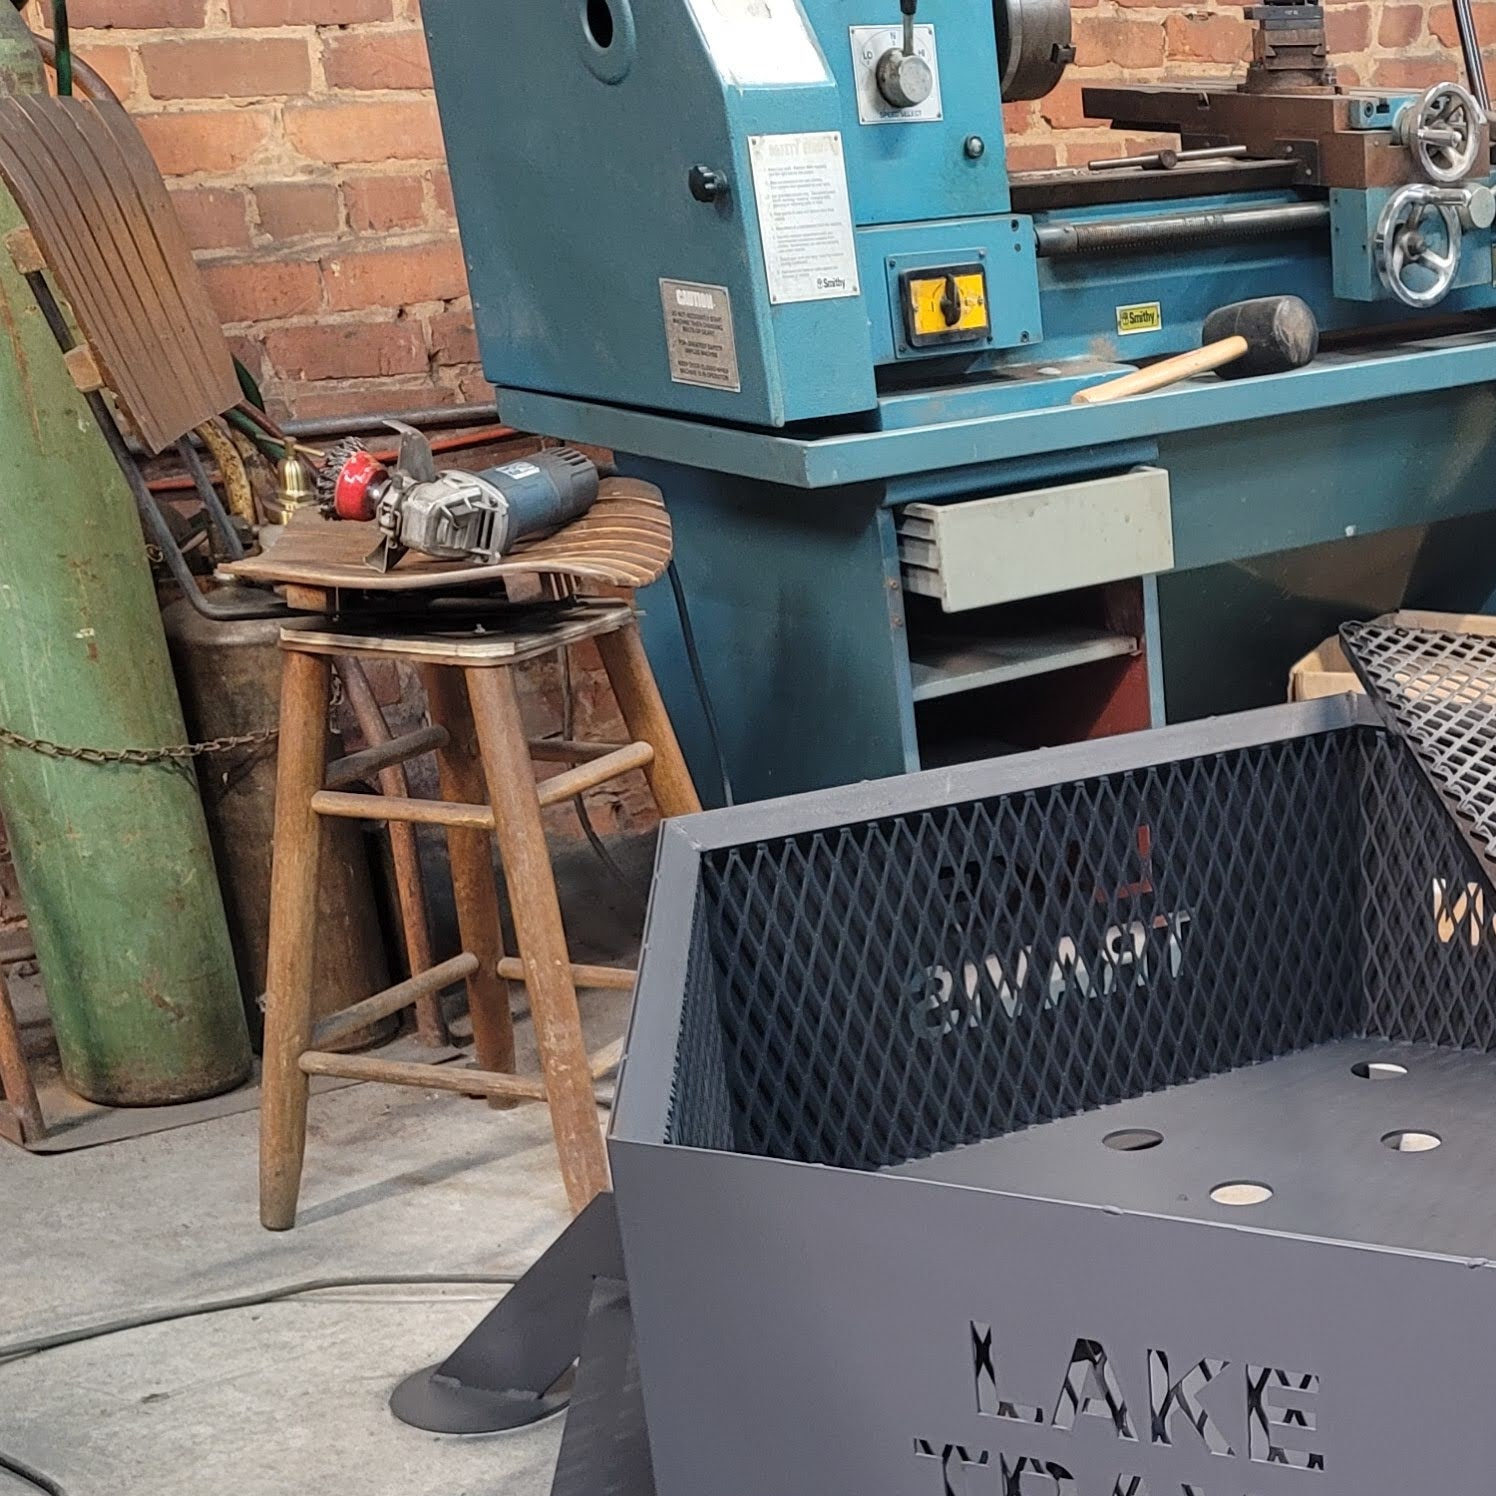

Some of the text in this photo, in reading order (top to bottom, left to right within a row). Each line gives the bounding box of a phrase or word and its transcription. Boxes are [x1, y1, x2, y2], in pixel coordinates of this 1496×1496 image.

[822, 277, 846, 290] Smithy
[1129, 310, 1155, 325] Smithy
[969, 1319, 1325, 1473] LAKE
